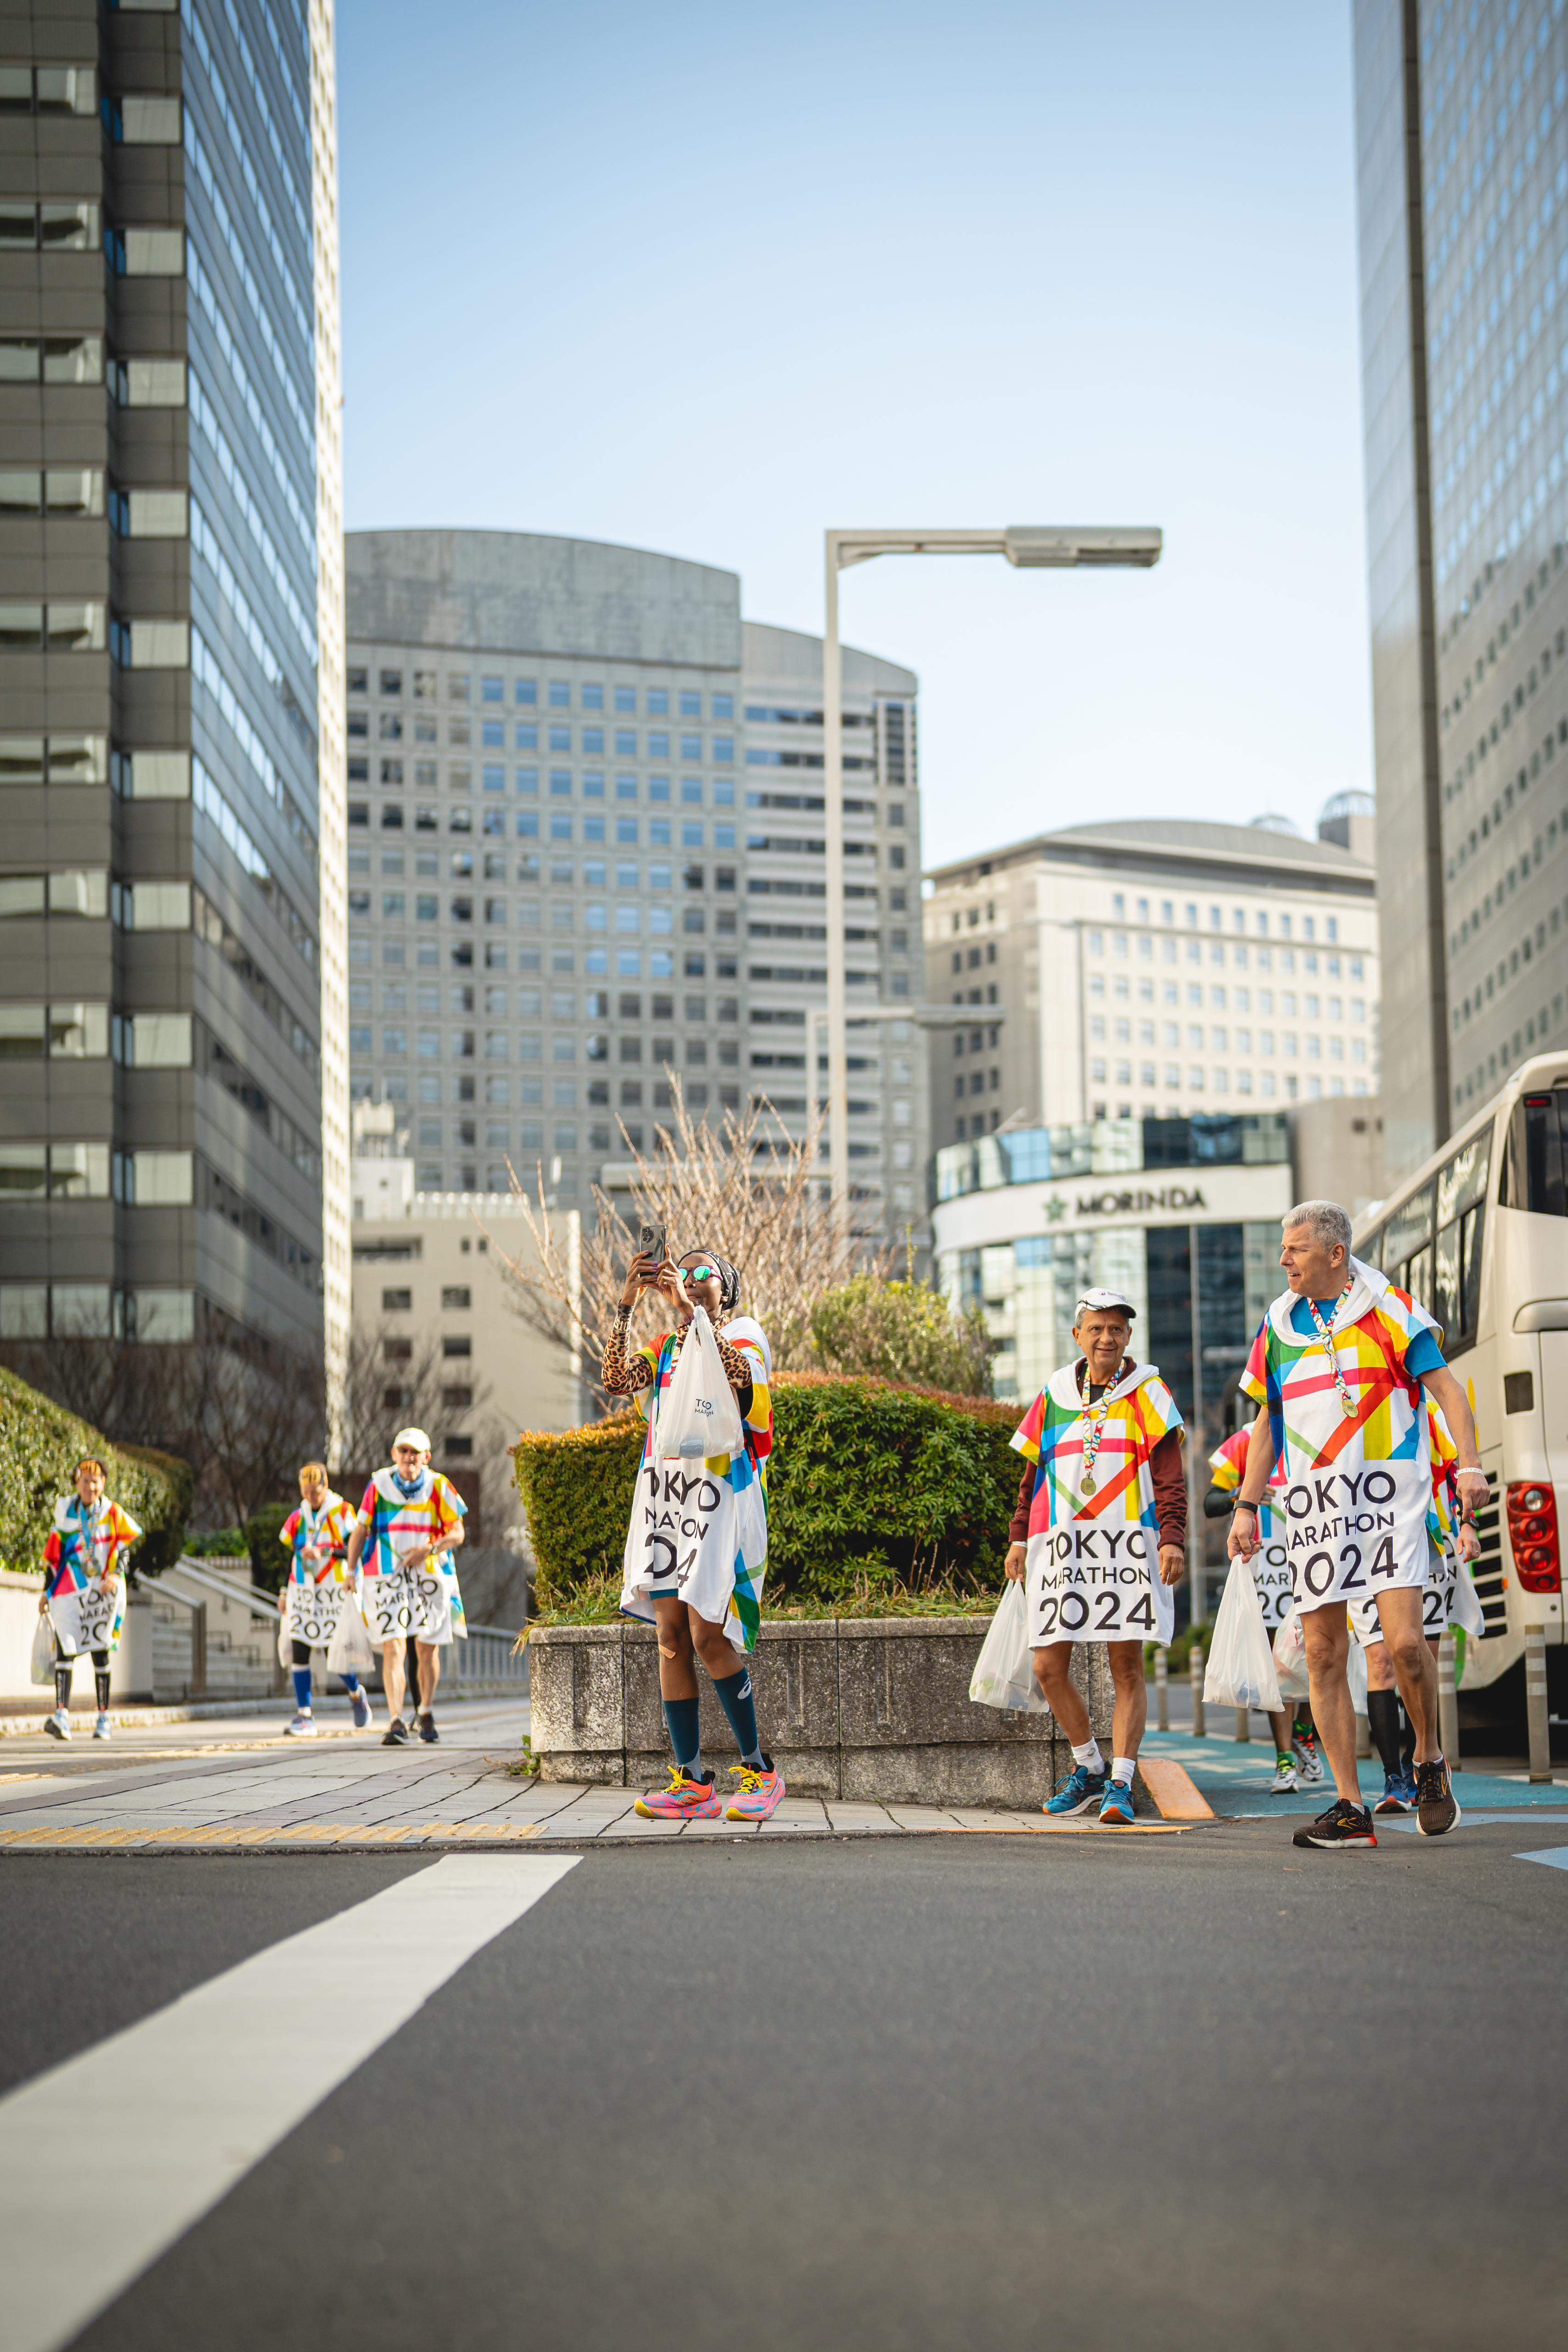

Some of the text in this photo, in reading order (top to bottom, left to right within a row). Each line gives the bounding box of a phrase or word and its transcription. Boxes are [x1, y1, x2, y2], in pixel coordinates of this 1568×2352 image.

[1077, 1187, 1205, 1214] MORINDA
[1046, 1530, 1147, 1566] TOKYO
[1038, 1591, 1156, 1636] 2024
